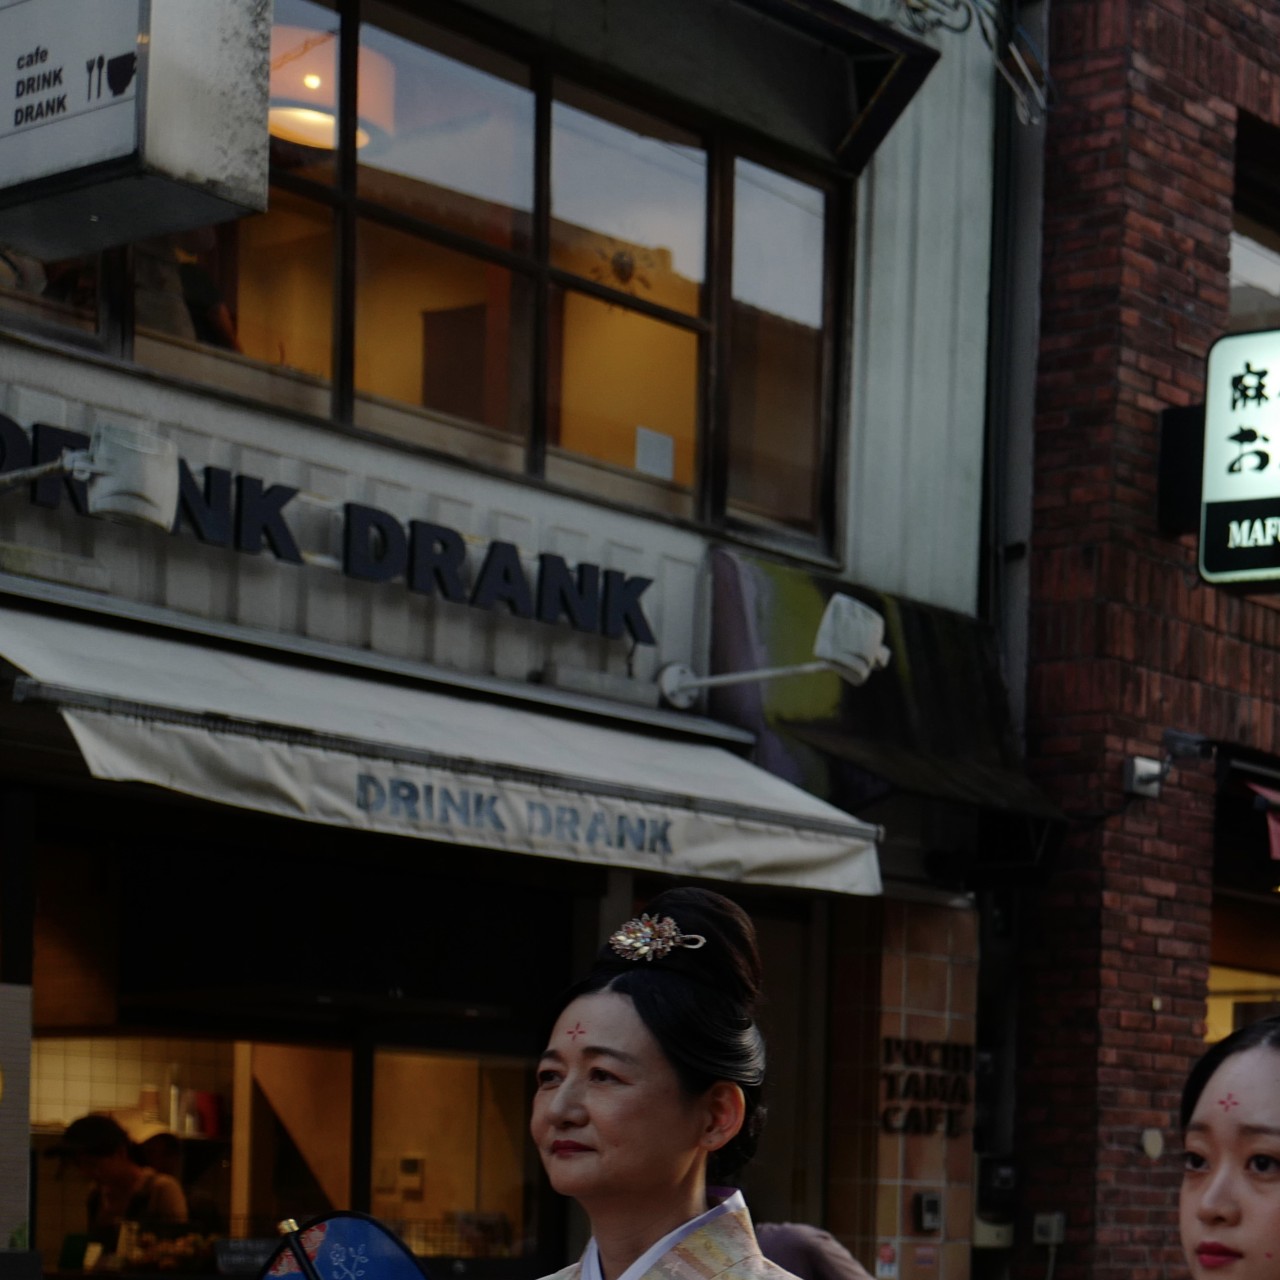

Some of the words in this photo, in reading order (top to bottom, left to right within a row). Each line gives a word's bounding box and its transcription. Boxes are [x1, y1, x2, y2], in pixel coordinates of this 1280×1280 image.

[16, 45, 49, 71] cafe
[15, 67, 63, 99] DRINK
[14, 94, 67, 127] DRANK
[0, 414, 304, 564] RNK
[343, 502, 656, 645] DRANK
[356, 773, 506, 832] DRINK
[527, 800, 673, 855] DRANK
[883, 1071, 970, 1105] TAMA
[883, 1106, 964, 1138] CAFE
